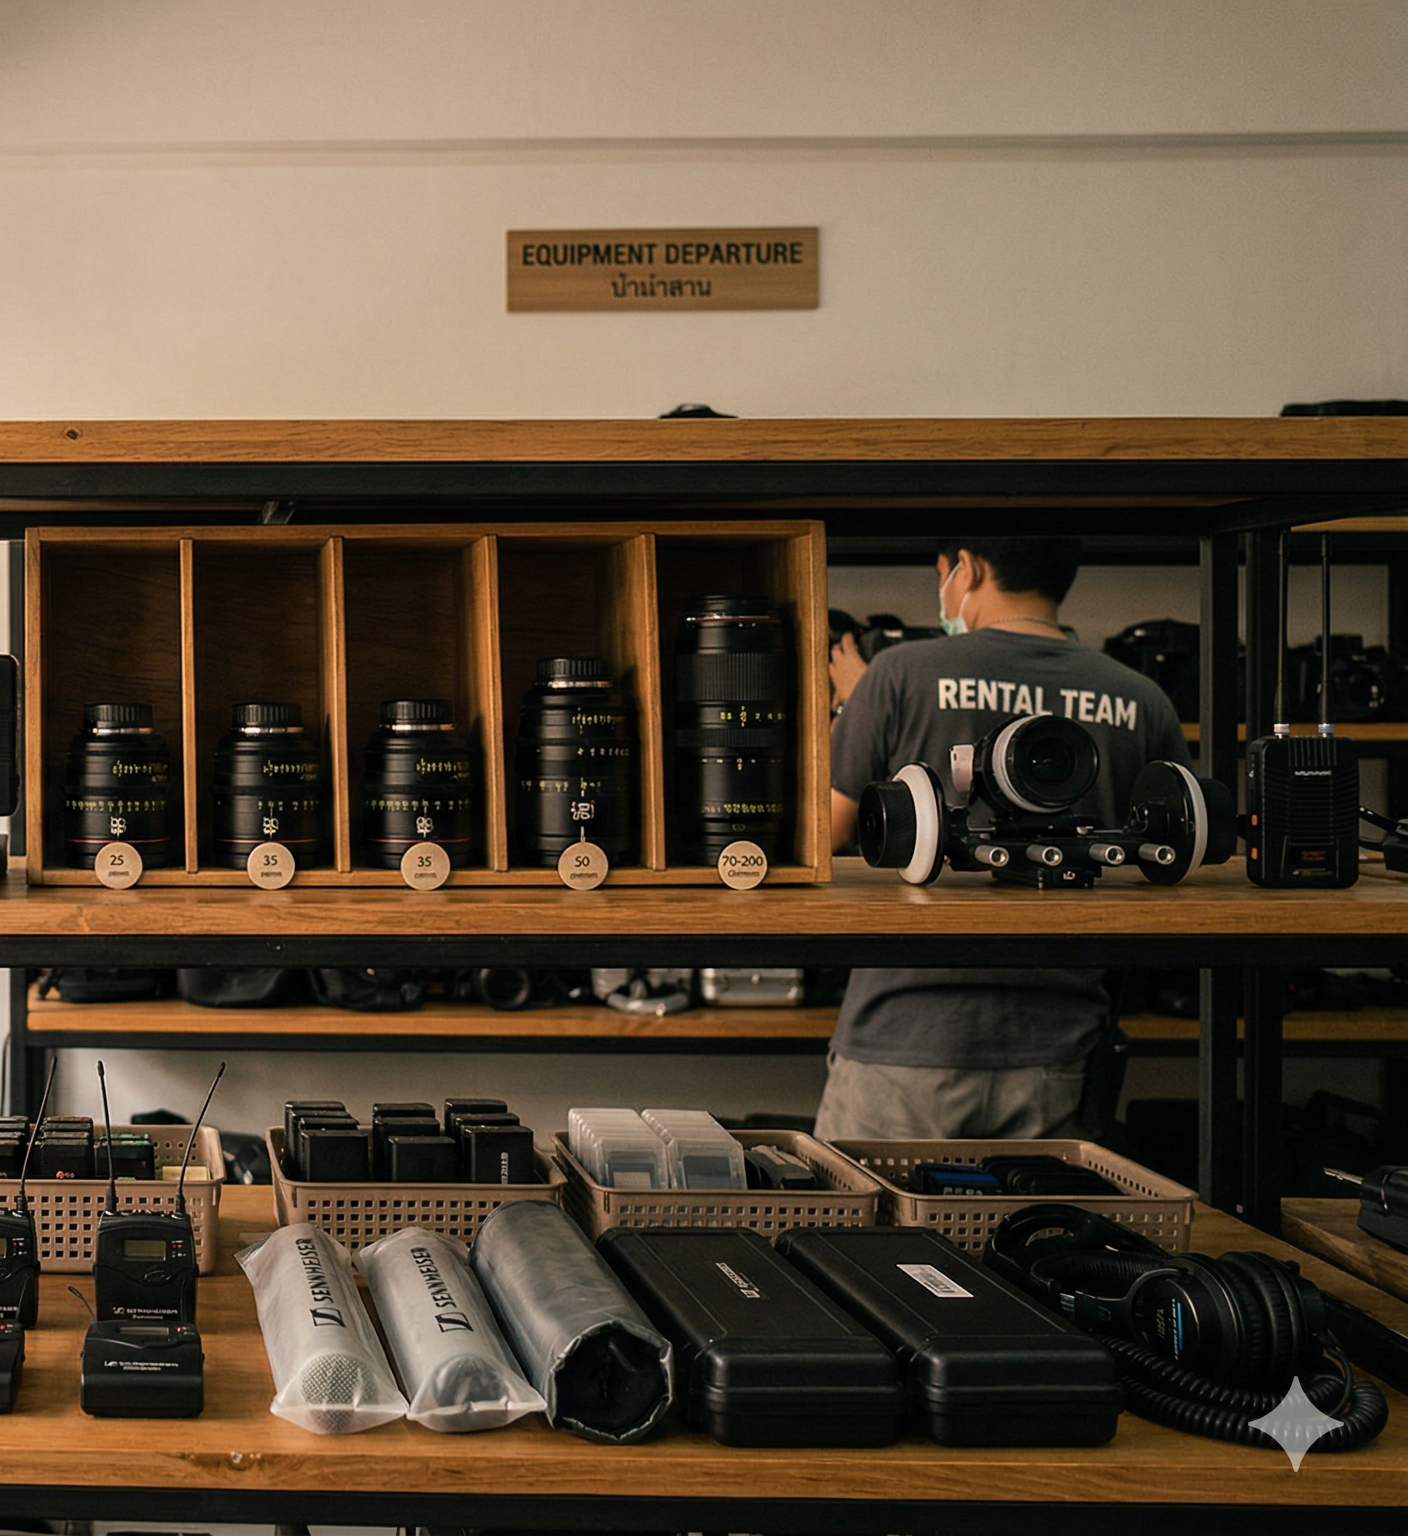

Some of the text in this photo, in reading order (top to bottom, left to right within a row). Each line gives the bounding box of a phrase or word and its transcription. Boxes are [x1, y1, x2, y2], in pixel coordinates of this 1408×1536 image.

[522, 242, 803, 266] EQUIPMENT DEPARTURE
[938, 678, 1137, 731] RENTAL TEAM
[110, 855, 124, 866] 25
[263, 855, 278, 866] 35
[417, 856, 432, 868] 35
[574, 856, 590, 868] 50
[722, 855, 764, 867] 70-200
[410, 1247, 457, 1309] SENNHEISE
